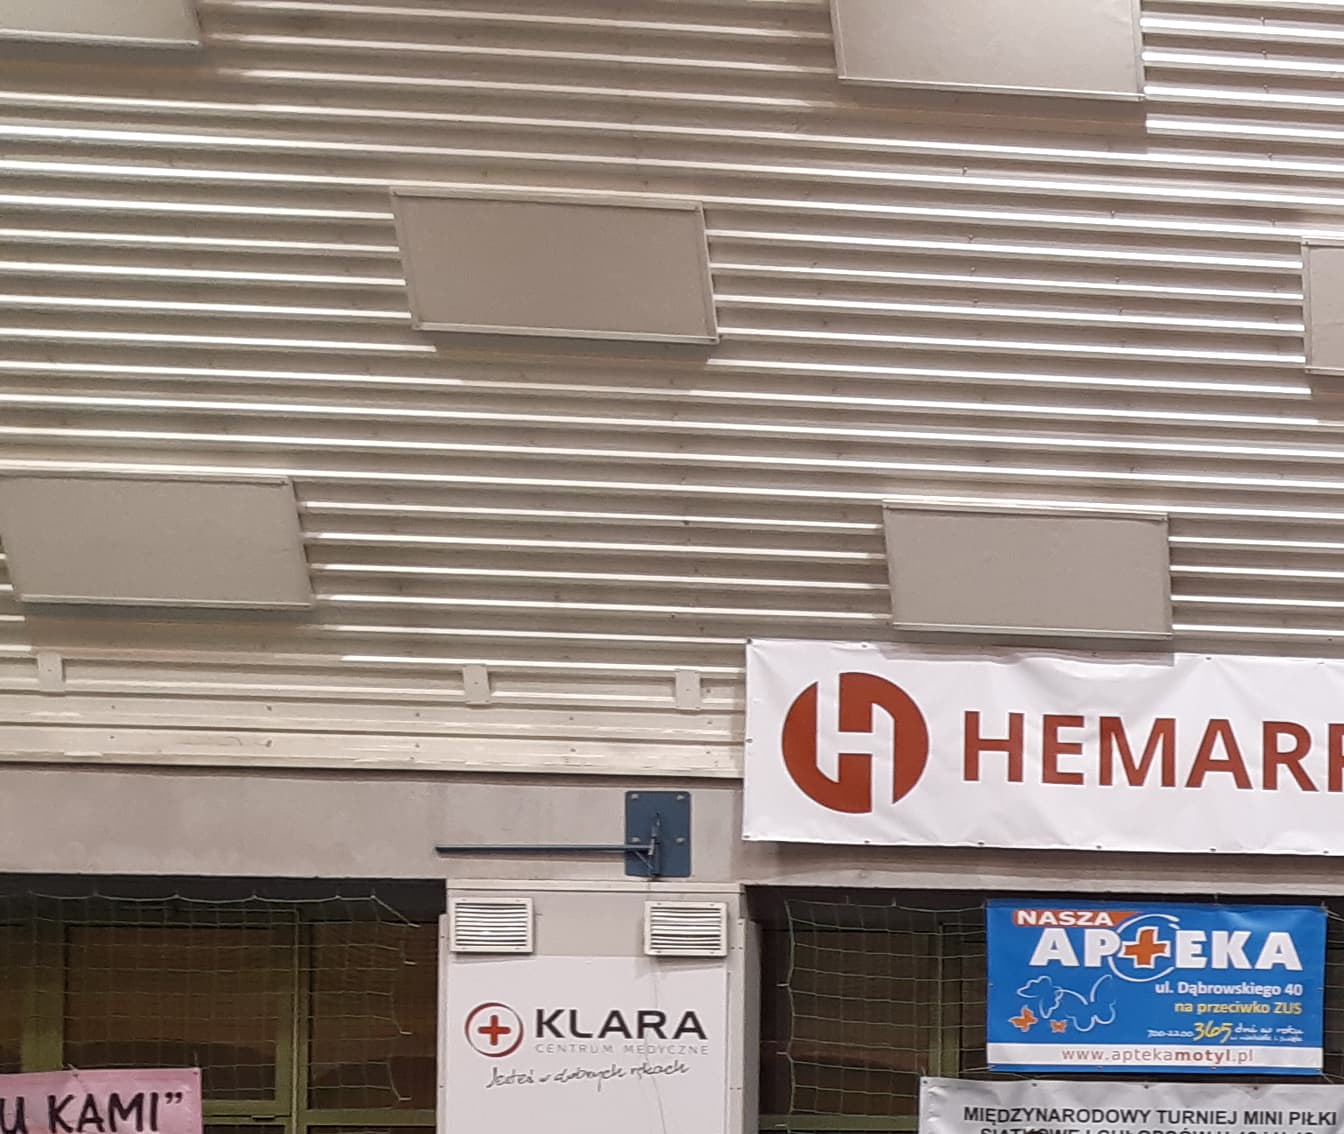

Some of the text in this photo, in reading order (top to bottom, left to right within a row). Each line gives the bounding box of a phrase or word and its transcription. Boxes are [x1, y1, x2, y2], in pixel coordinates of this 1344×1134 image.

[1016, 910, 1113, 927] NASZA
[1155, 981, 1304, 998] ul. Dąbrowskiego 40
[1174, 1001, 1303, 1016] na przeciwko ZUS
[535, 1008, 708, 1040] KLARA
[1193, 1021, 1233, 1044] 365
[535, 1043, 709, 1056] CENTRUM MEDYCZNE
[1062, 1046, 1255, 1064] www.aptekamotyl.pl
[962, 1106, 1338, 1127] MIĘDZYNARODOWY TURNIEJ MINI PIŁKI
